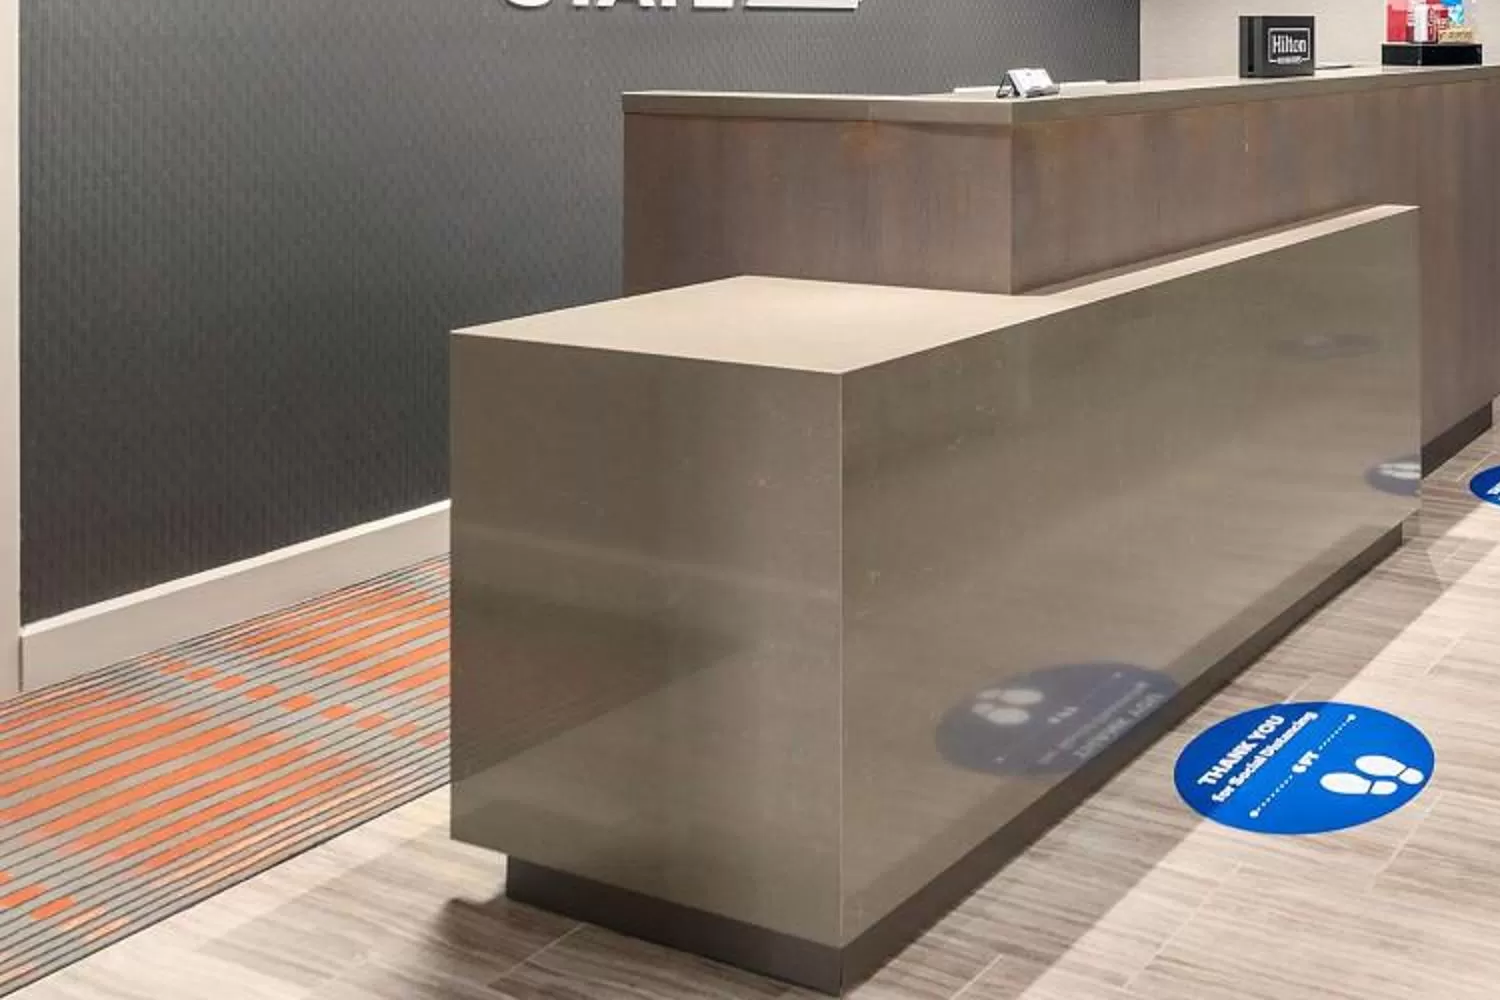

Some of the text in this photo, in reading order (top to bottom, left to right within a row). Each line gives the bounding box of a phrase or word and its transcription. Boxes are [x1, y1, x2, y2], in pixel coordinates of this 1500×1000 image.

[1272, 33, 1307, 54] Hilton
[1197, 714, 1285, 785] THANK YOU
